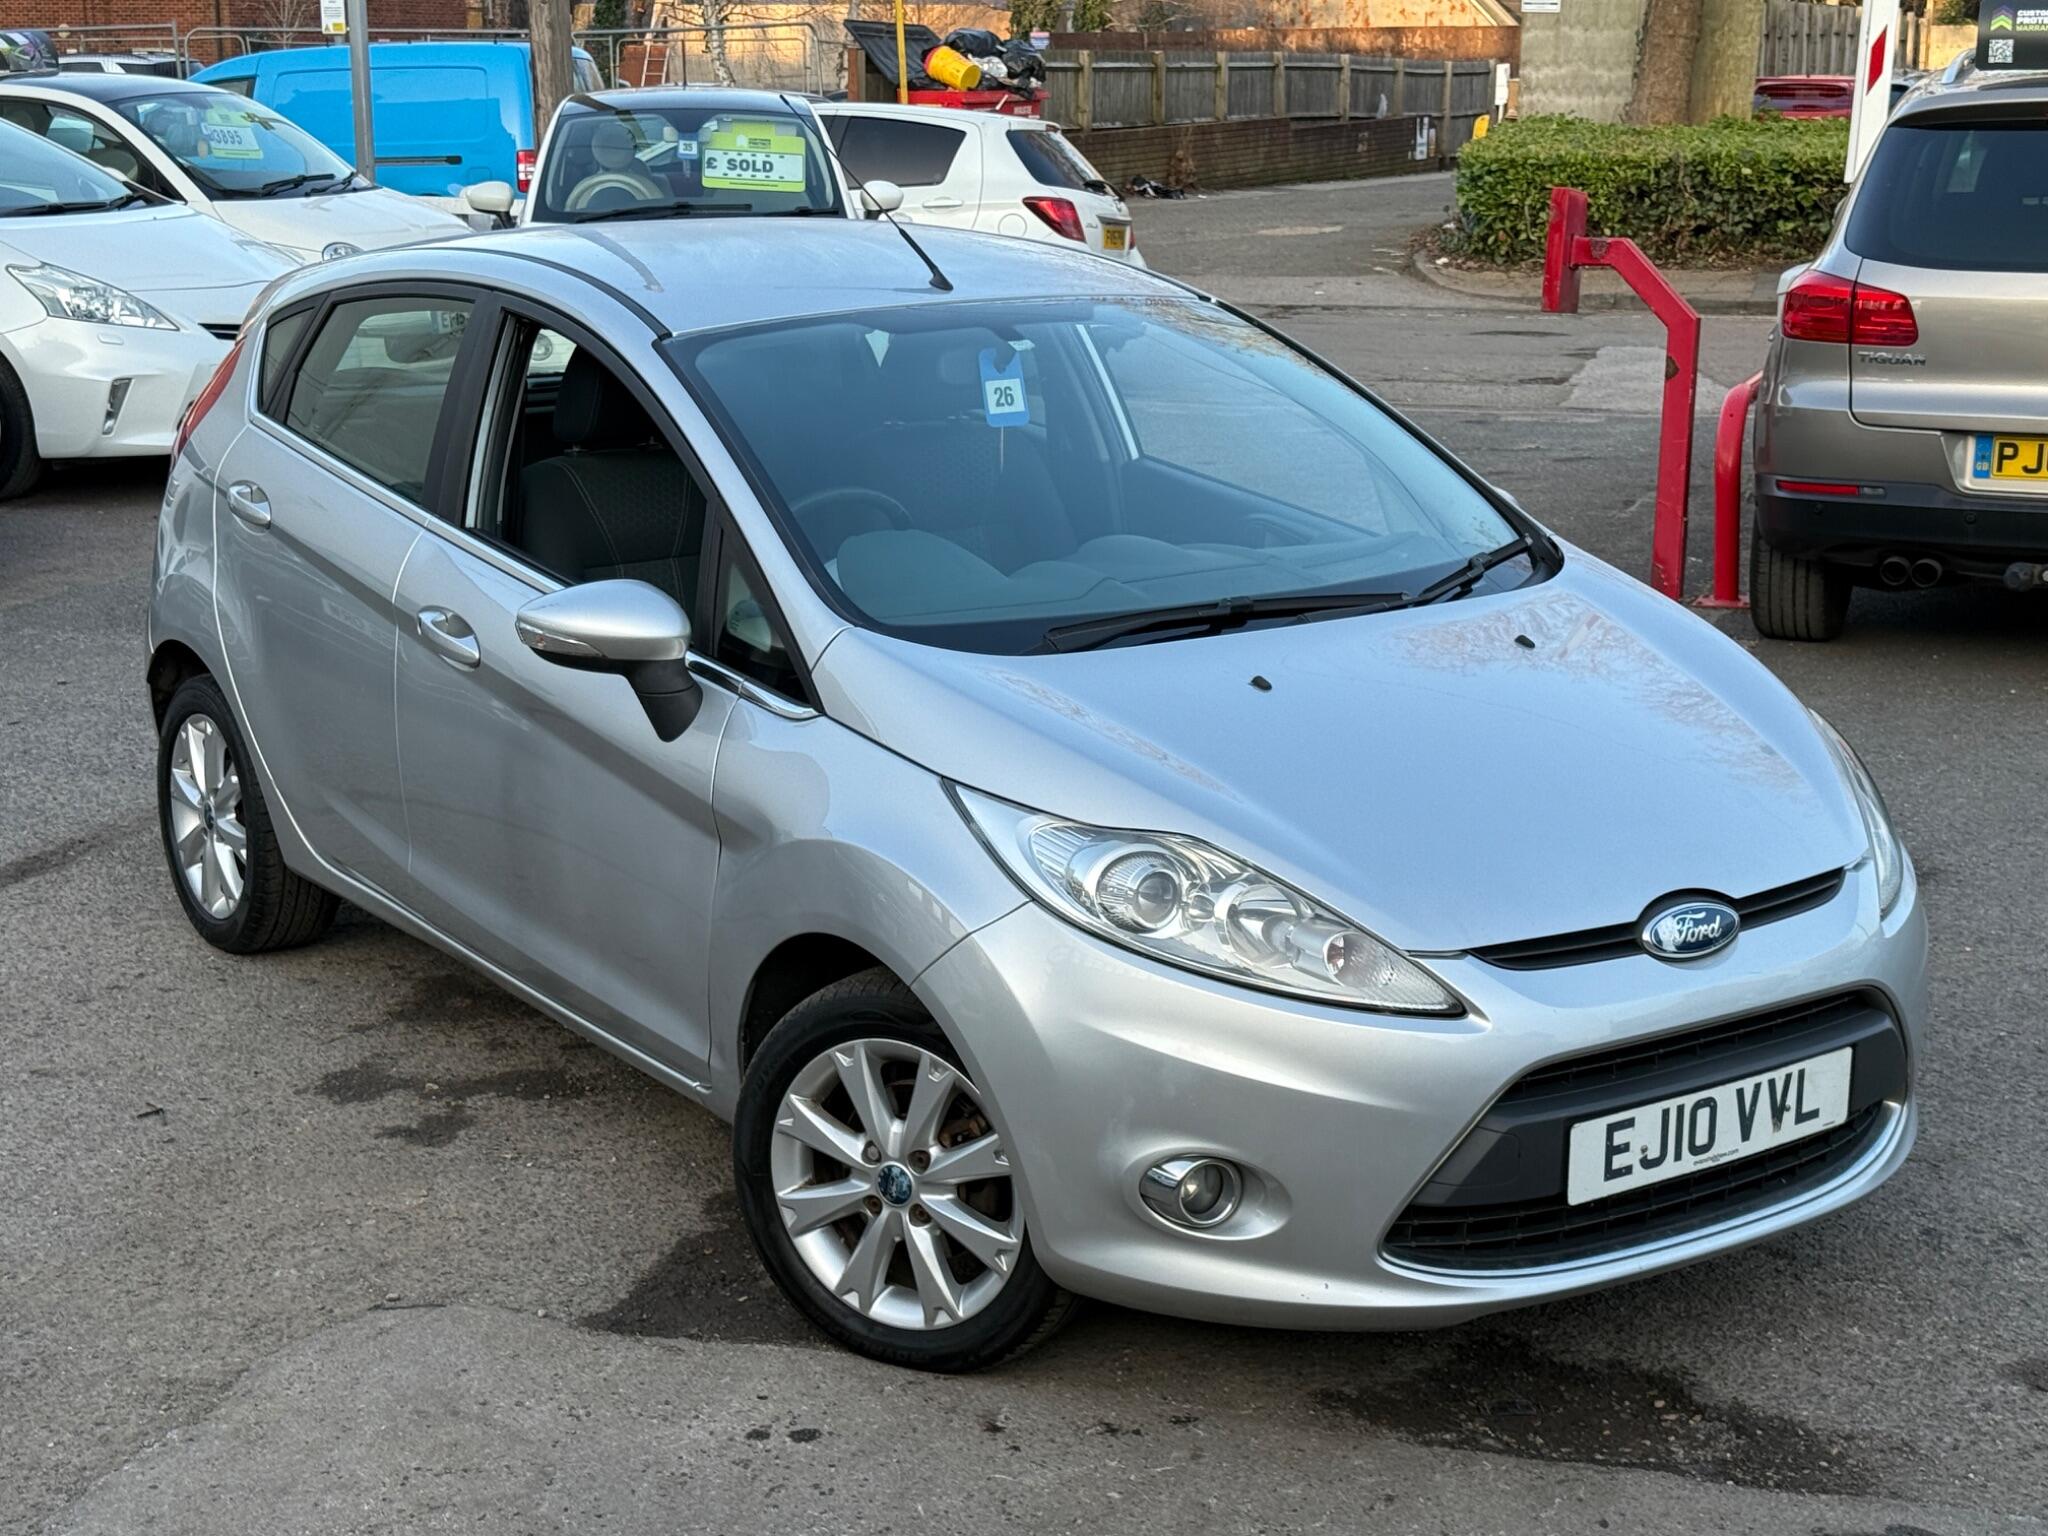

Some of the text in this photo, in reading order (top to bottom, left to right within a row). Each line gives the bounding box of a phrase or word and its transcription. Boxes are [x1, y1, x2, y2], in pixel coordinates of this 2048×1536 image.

[706, 157, 774, 173] £ SOLD
[1857, 351, 1927, 367] TIGUAN
[994, 386, 1015, 408] 26
[1996, 442, 2048, 474] PJ
[1674, 911, 1722, 946] Ford
[1604, 1068, 1820, 1182] EJ10 VVL
